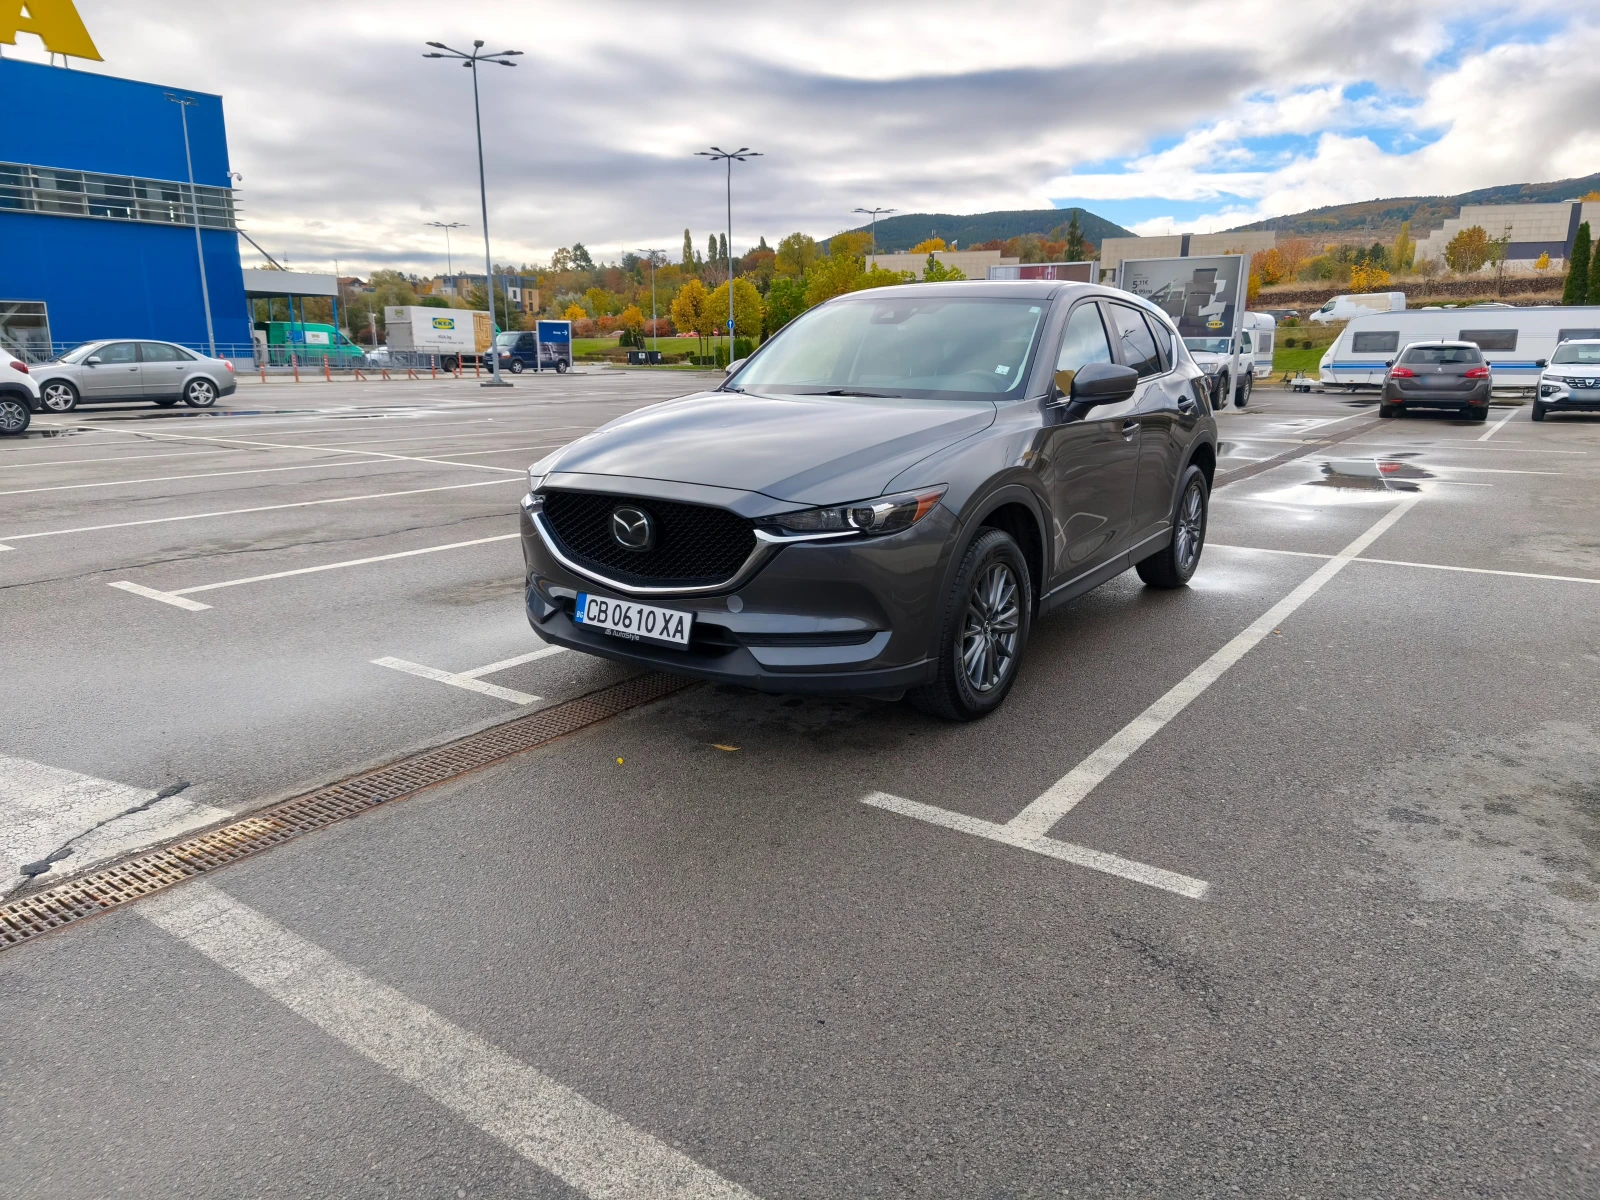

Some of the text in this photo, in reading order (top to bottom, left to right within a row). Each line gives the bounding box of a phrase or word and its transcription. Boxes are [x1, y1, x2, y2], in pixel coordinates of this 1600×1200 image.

[586, 599, 684, 640] CB 0610 XA
